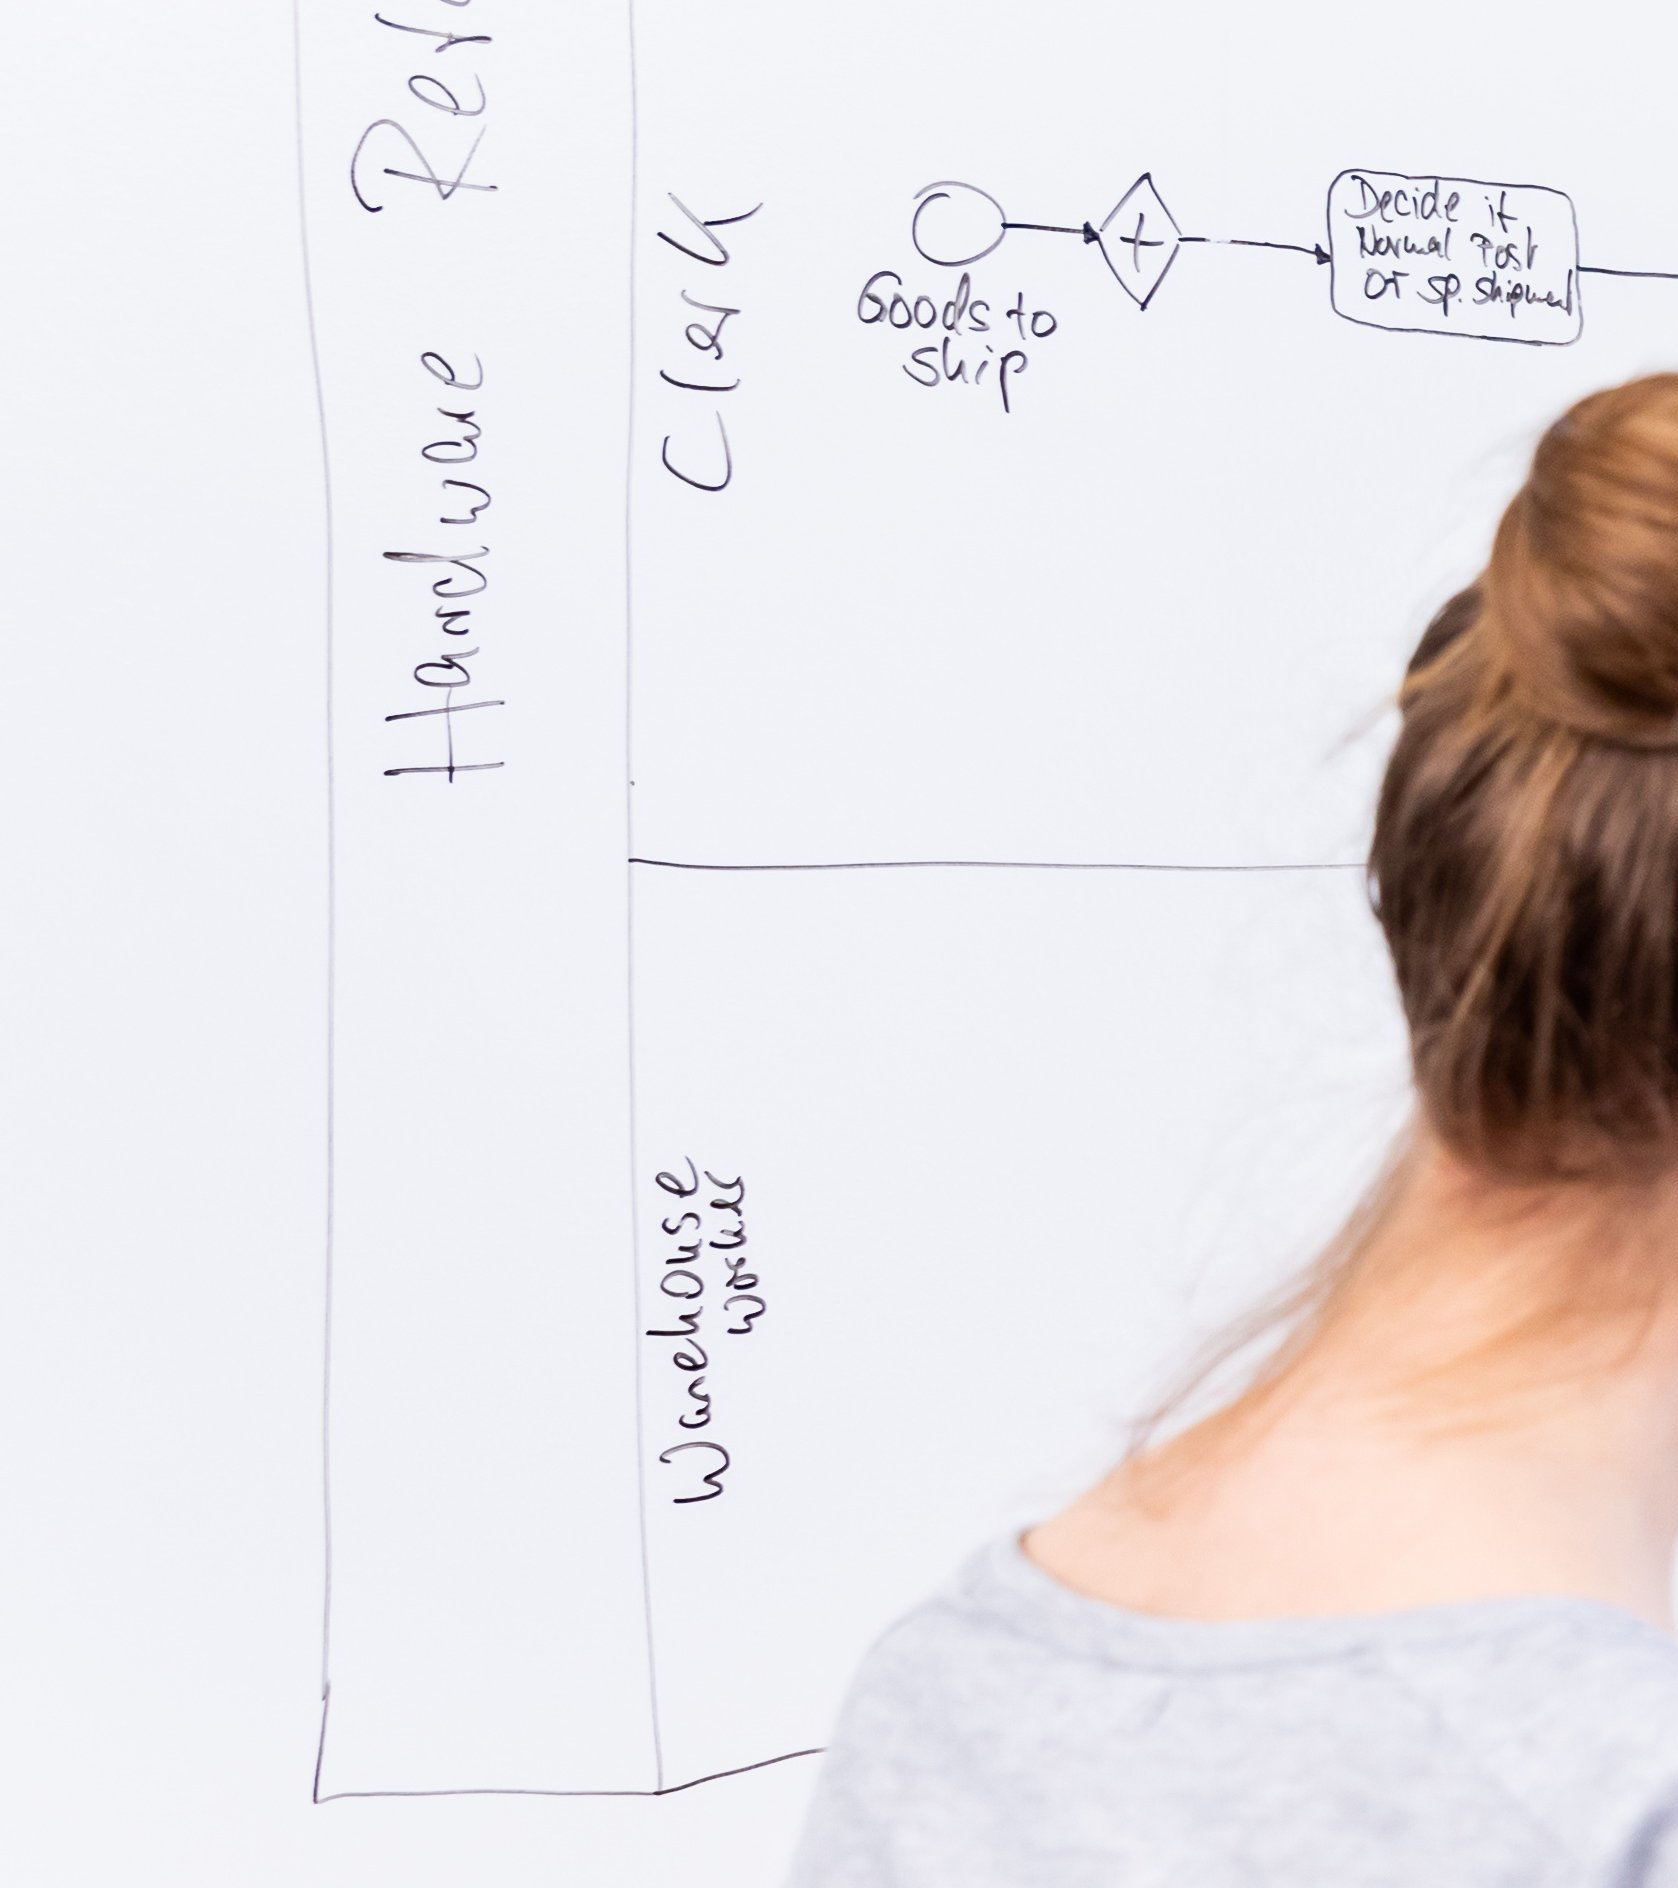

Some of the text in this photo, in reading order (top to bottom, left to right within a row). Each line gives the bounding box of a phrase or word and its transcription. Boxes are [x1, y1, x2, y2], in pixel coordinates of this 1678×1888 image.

[1340, 170, 1465, 225] Decide
[1354, 224, 1453, 263] Normal
[855, 269, 1061, 342] Goods to
[900, 328, 1037, 416] ship
[380, 350, 507, 786] Hardware
[643, 1154, 733, 1506] Warehouse
